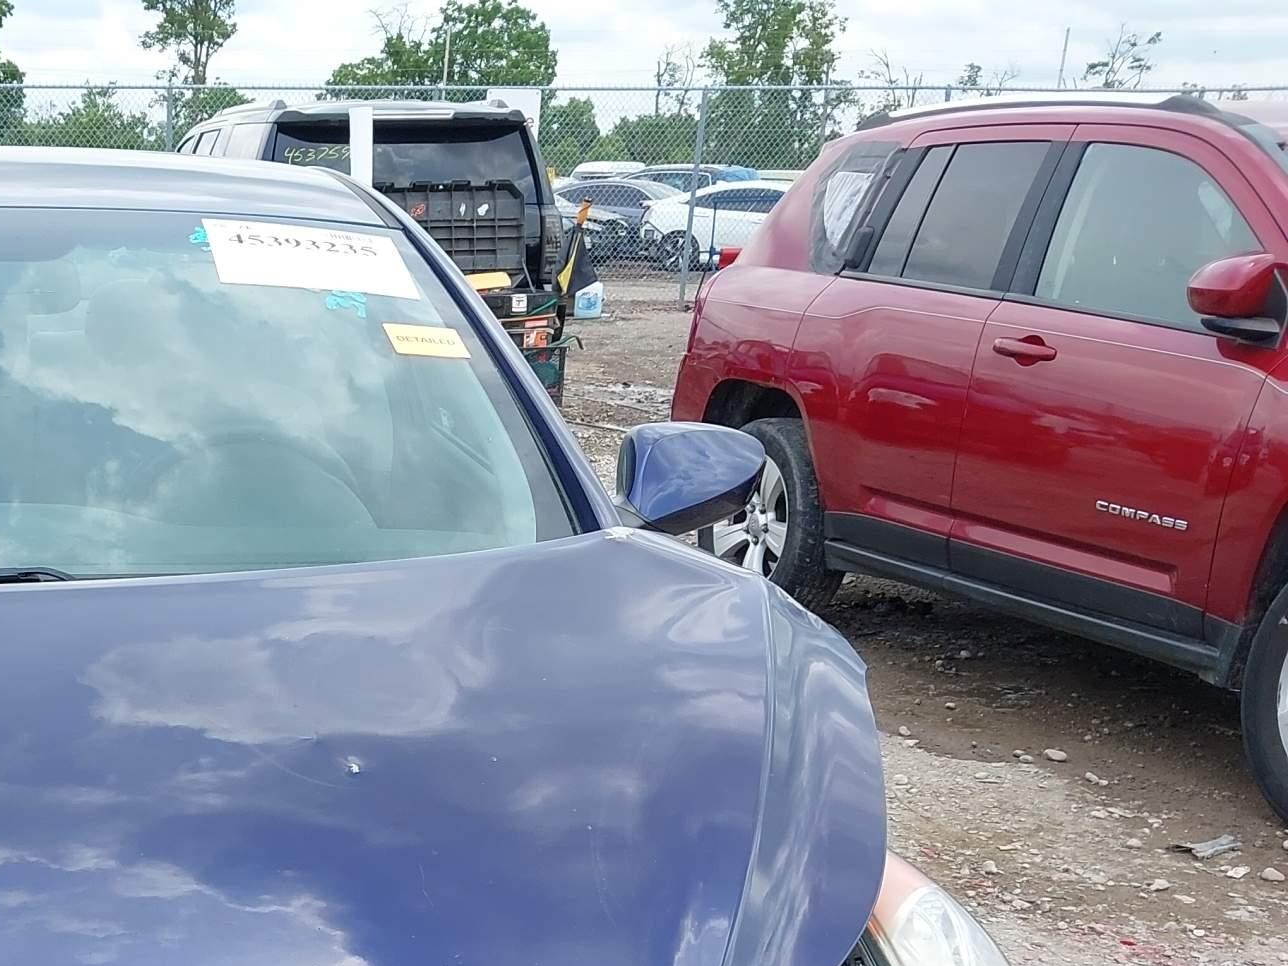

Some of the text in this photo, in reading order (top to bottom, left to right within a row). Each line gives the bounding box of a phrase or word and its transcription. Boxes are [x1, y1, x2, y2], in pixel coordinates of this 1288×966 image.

[228, 232, 377, 257] 45393235
[395, 335, 455, 346] DETAILED
[1095, 500, 1188, 531] COMPASS
